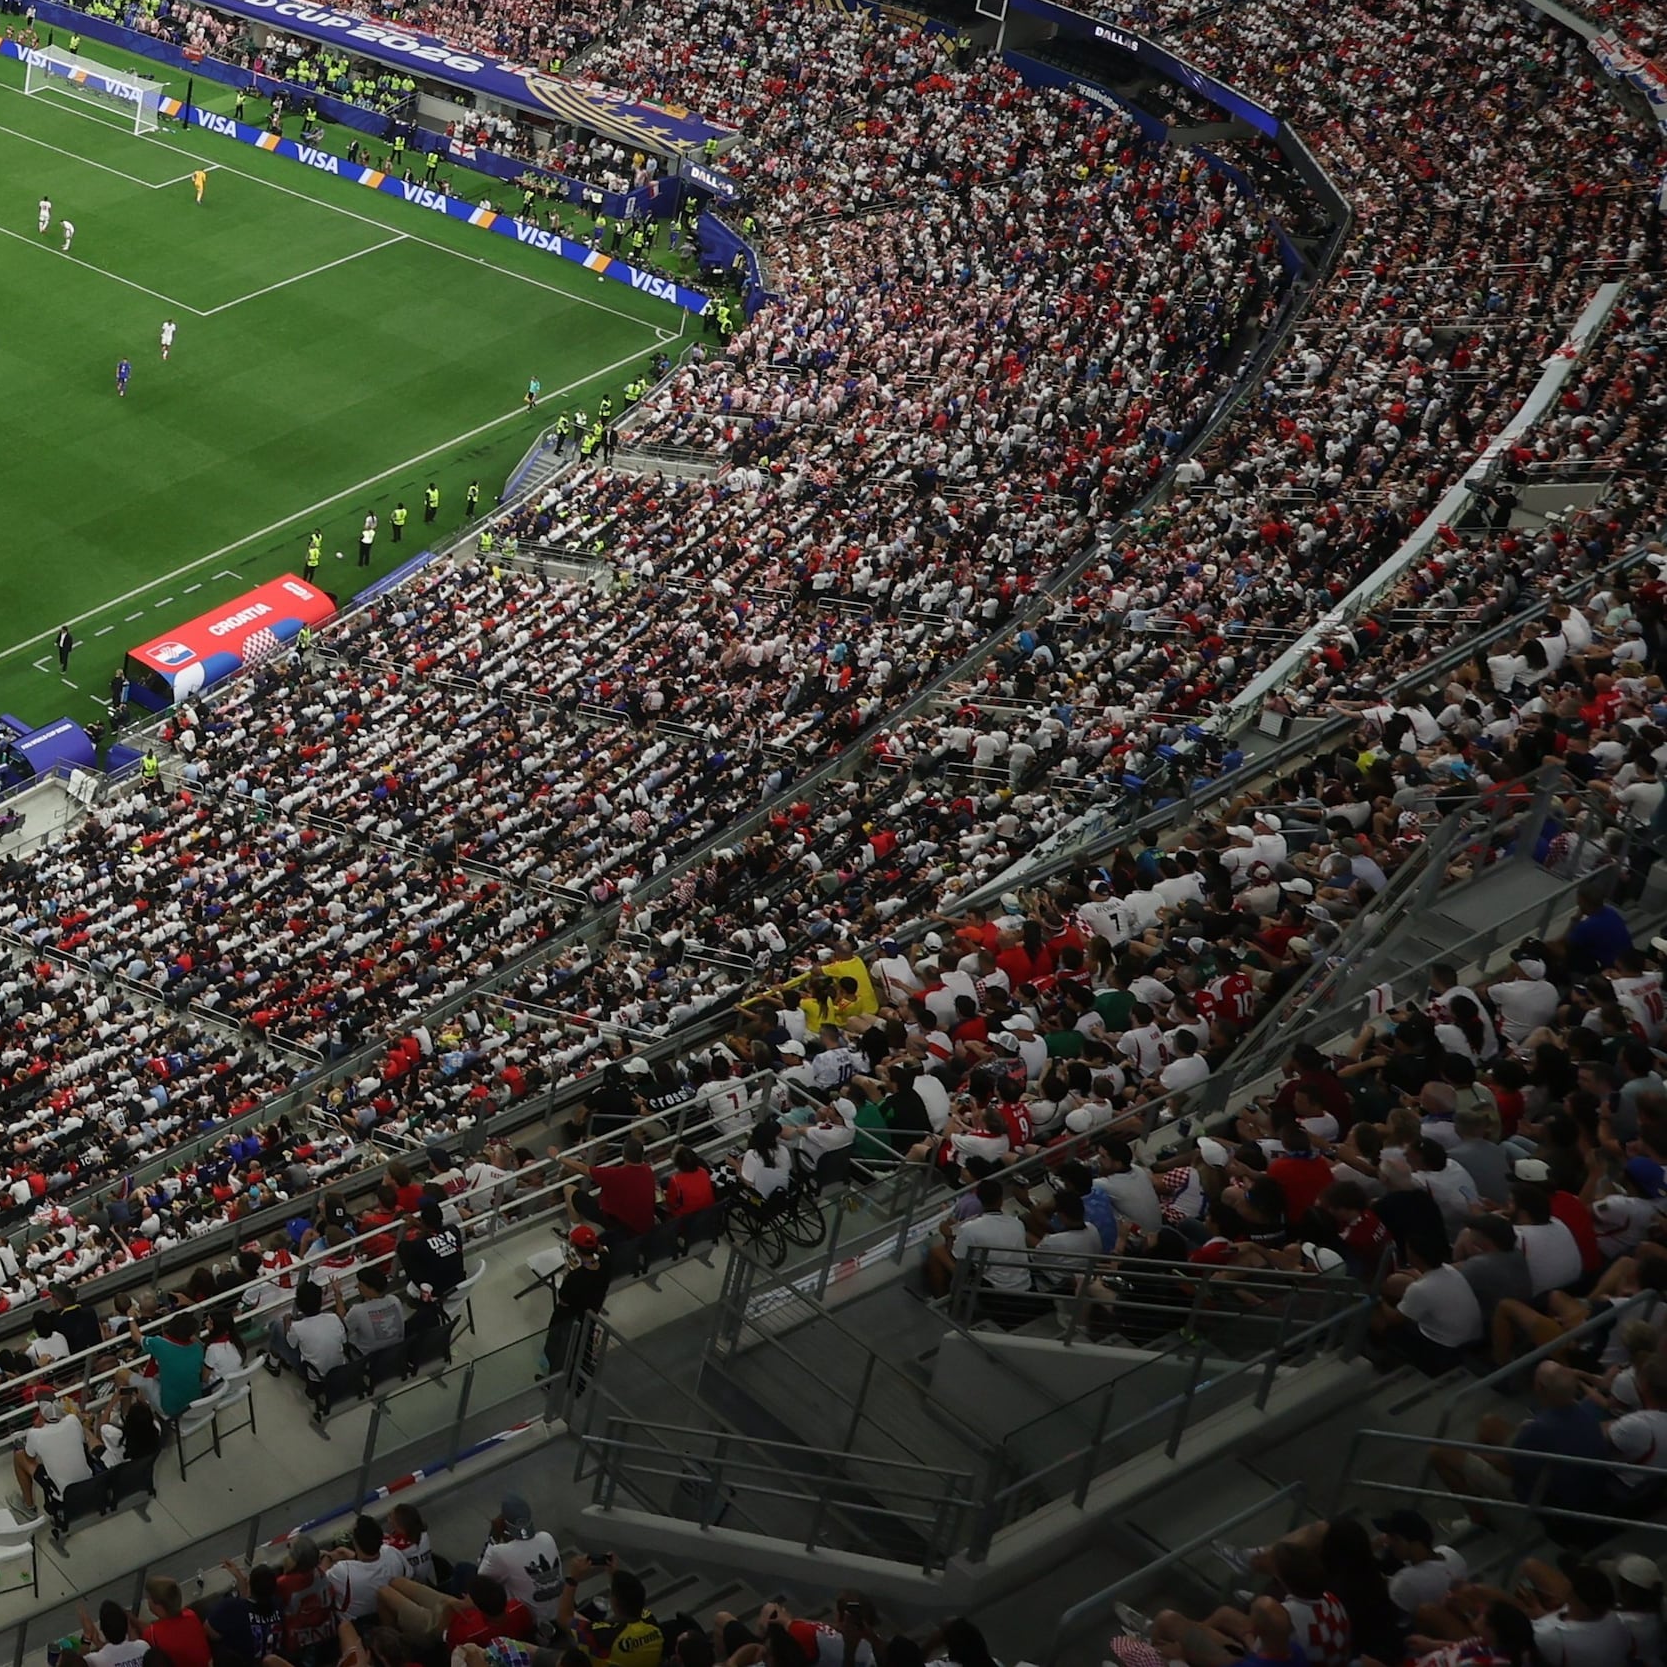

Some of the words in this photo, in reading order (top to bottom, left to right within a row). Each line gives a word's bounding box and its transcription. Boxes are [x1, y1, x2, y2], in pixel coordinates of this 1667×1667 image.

[347, 24, 484, 74] 2026
[1095, 26, 1139, 51] DALLAS
[195, 109, 238, 139] VISA
[690, 167, 734, 195] DALLAS
[514, 221, 563, 257] VISA
[627, 266, 679, 303] VISA
[208, 602, 273, 637] CROATIA
[1110, 914, 1121, 933] 7
[1232, 990, 1253, 1018] 10
[1018, 1118, 1029, 1144] 9
[427, 1230, 457, 1251] USA
